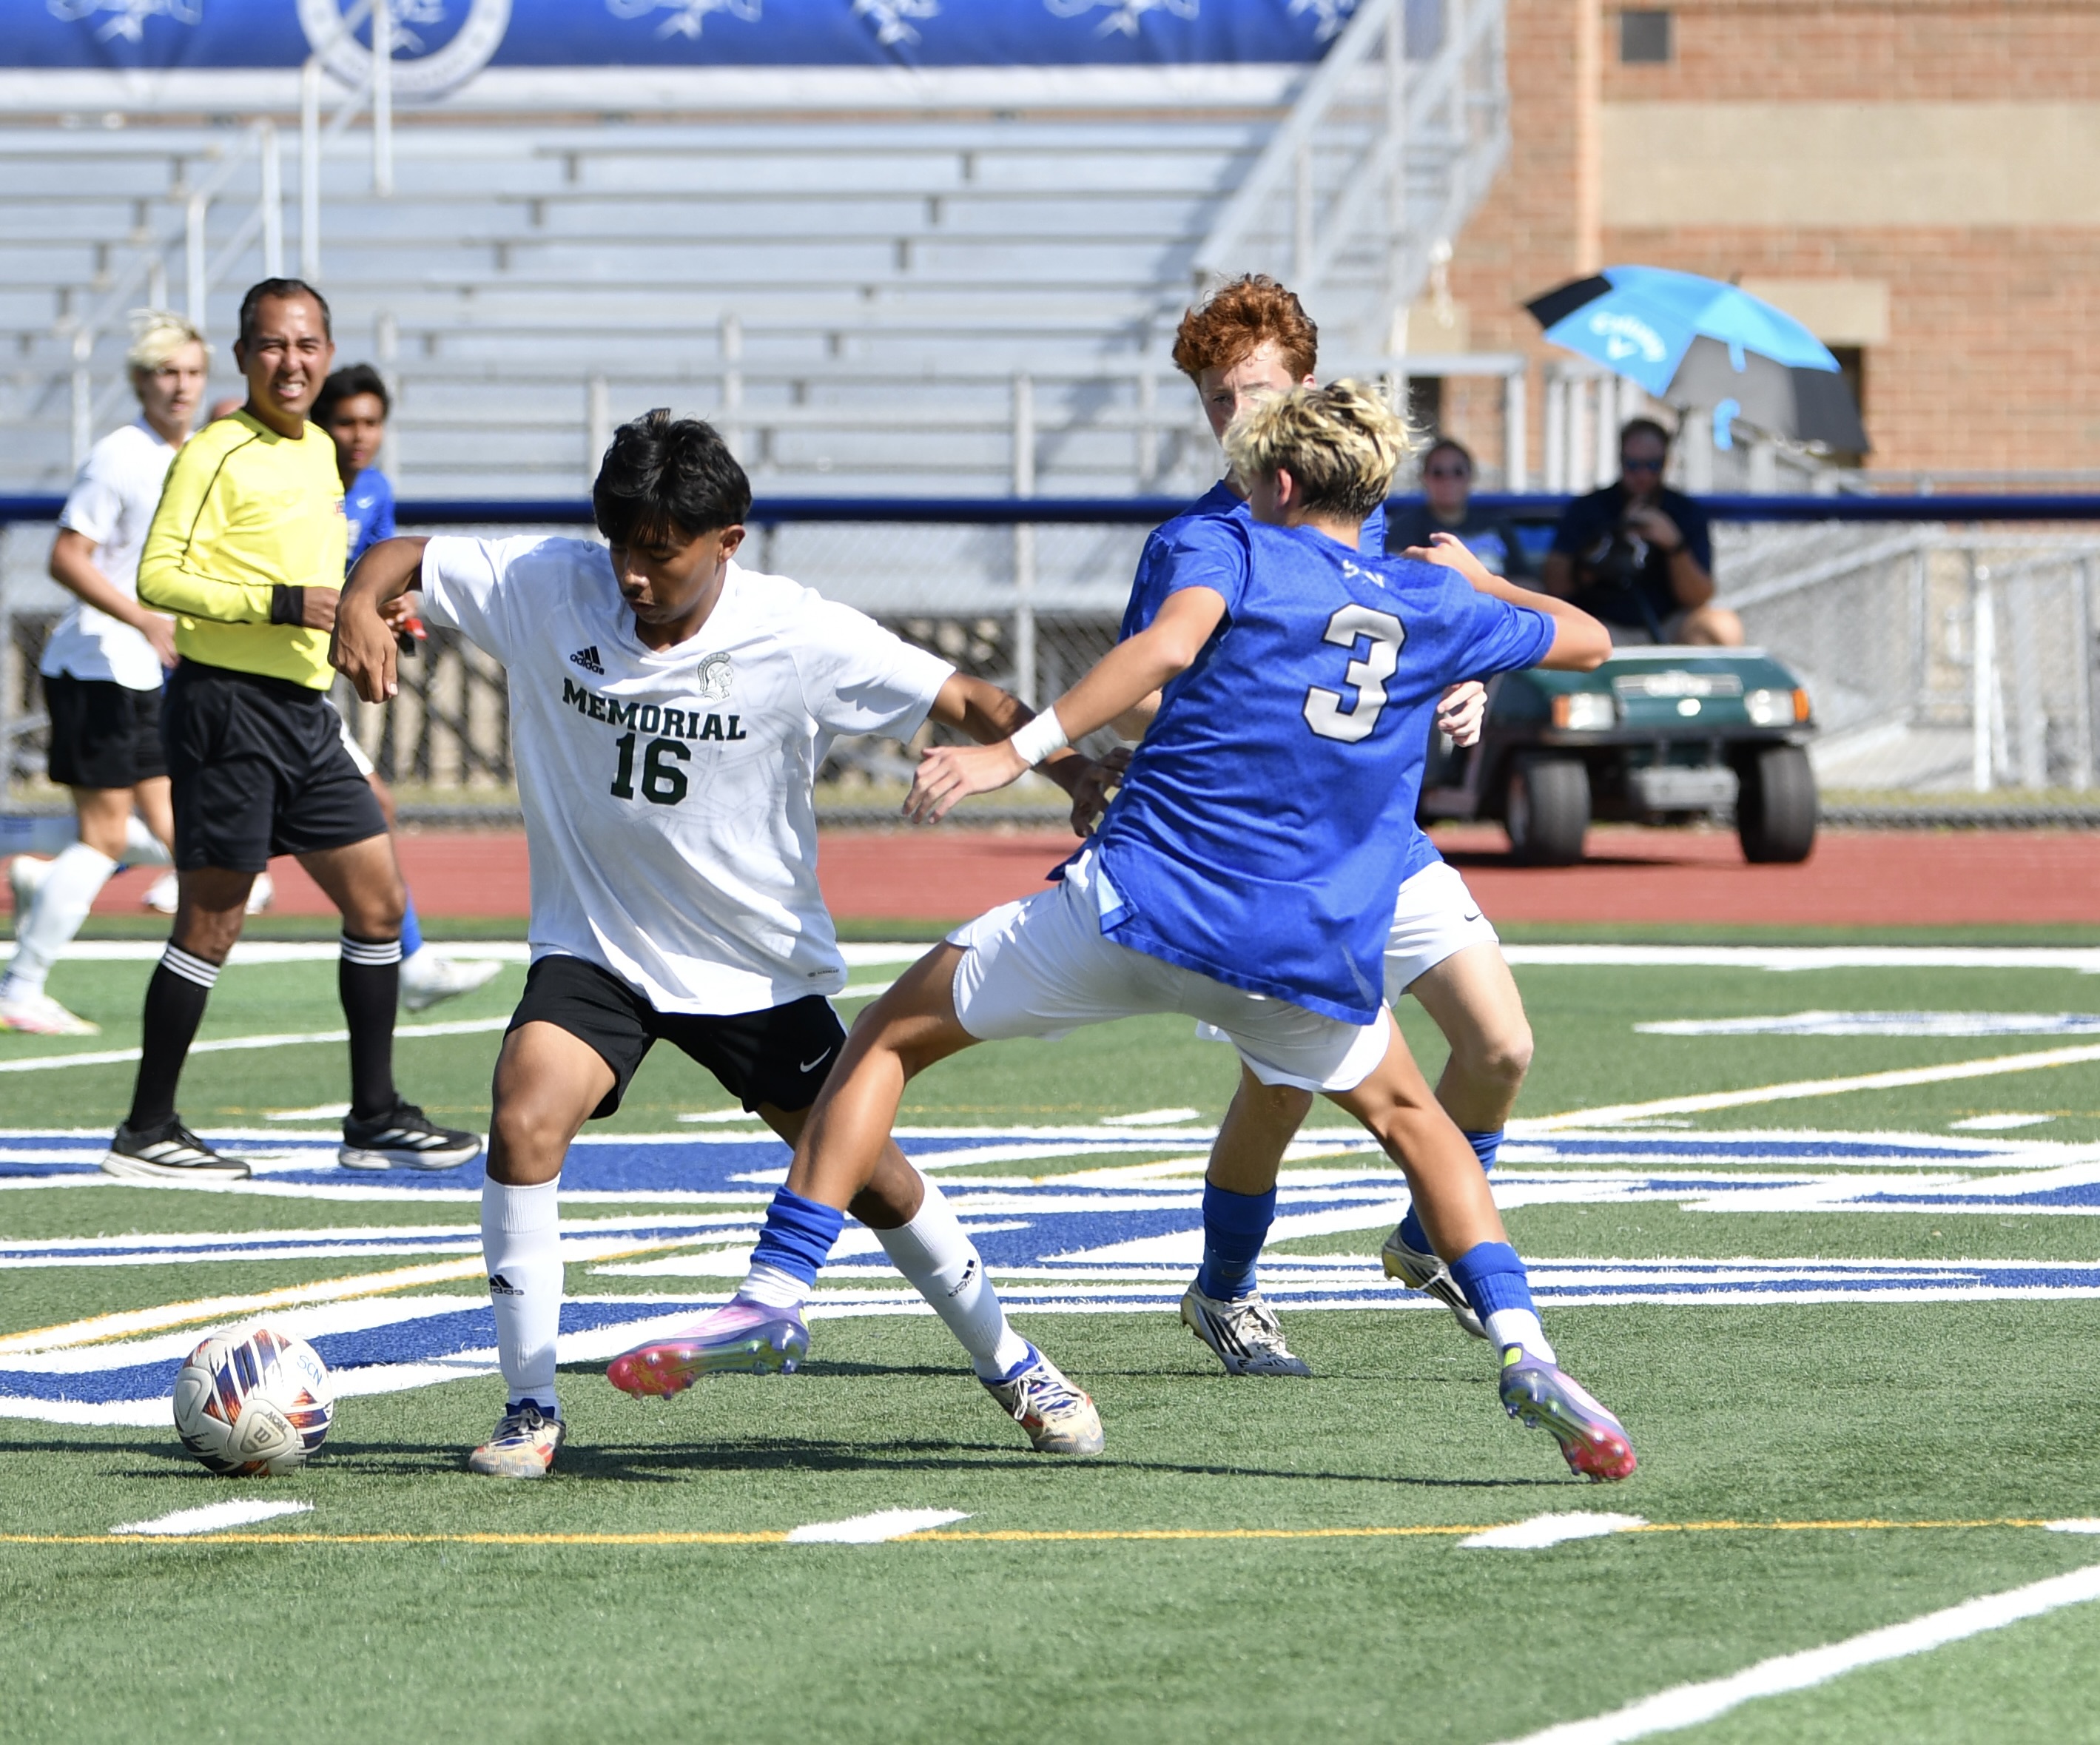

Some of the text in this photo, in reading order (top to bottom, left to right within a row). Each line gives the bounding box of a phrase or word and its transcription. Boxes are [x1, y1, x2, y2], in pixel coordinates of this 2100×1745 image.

[569, 653, 605, 676] adidas
[1302, 601, 1407, 745] 3
[562, 676, 747, 742] MEMORIAL
[610, 733, 692, 806] 16
[297, 1355, 323, 1387] SCN
